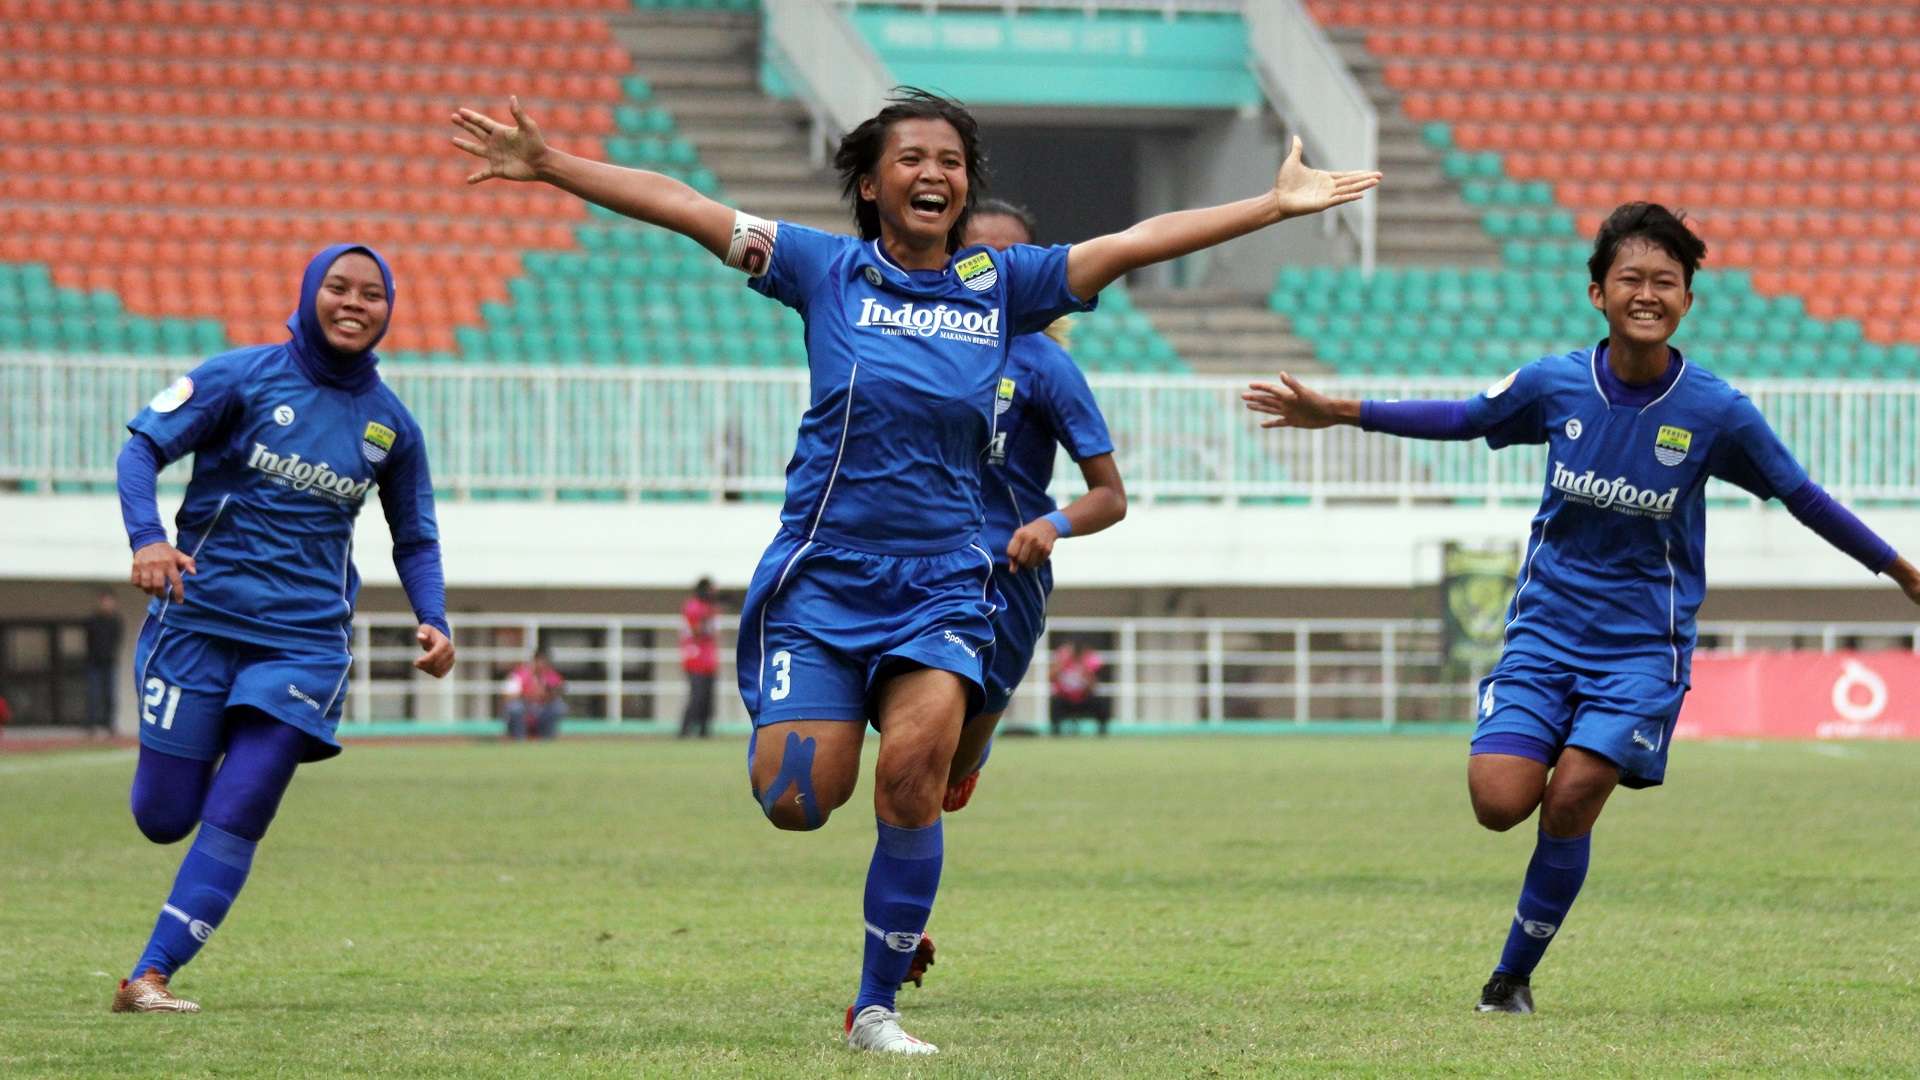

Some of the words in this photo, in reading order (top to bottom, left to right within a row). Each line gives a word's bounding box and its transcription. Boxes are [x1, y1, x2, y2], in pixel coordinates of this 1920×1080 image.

[856, 298, 1000, 337] Indofood
[248, 442, 371, 498] Indofood
[1551, 461, 1679, 510] Indofood
[770, 650, 792, 701] 3
[143, 677, 182, 730] 21
